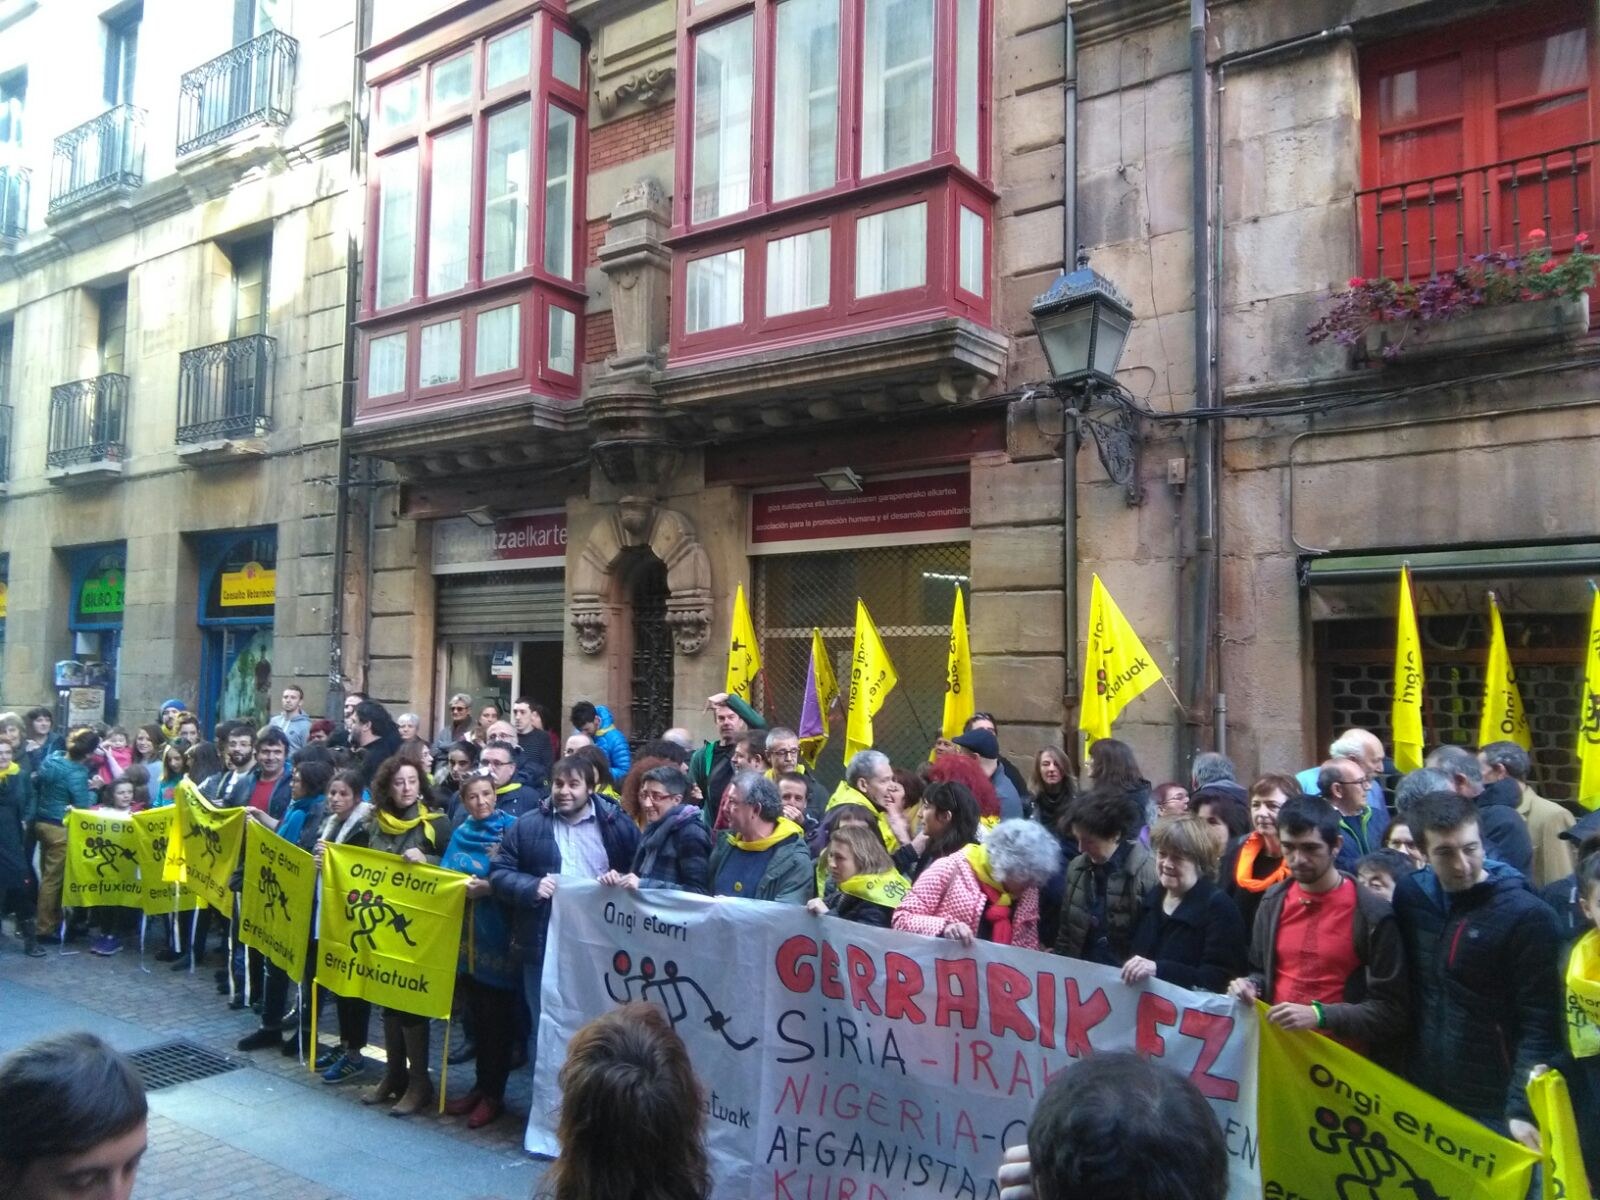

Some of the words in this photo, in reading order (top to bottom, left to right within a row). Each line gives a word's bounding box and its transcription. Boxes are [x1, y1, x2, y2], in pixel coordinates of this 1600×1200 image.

[928, 488, 956, 497] elkartea
[790, 521, 804, 529] para
[813, 517, 847, 528] promoción
[848, 514, 875, 523] humana
[891, 510, 925, 520] desarrollo
[927, 507, 971, 517] comunitario
[391, 867, 439, 895] etorri
[604, 902, 637, 936] Ongi
[643, 909, 688, 943] etorri
[324, 951, 430, 994] errefuxiatuak
[775, 934, 1112, 1058] GERRARIK
[1224, 1117, 1258, 1170] EN
[1393, 1110, 1497, 1178] etorri
